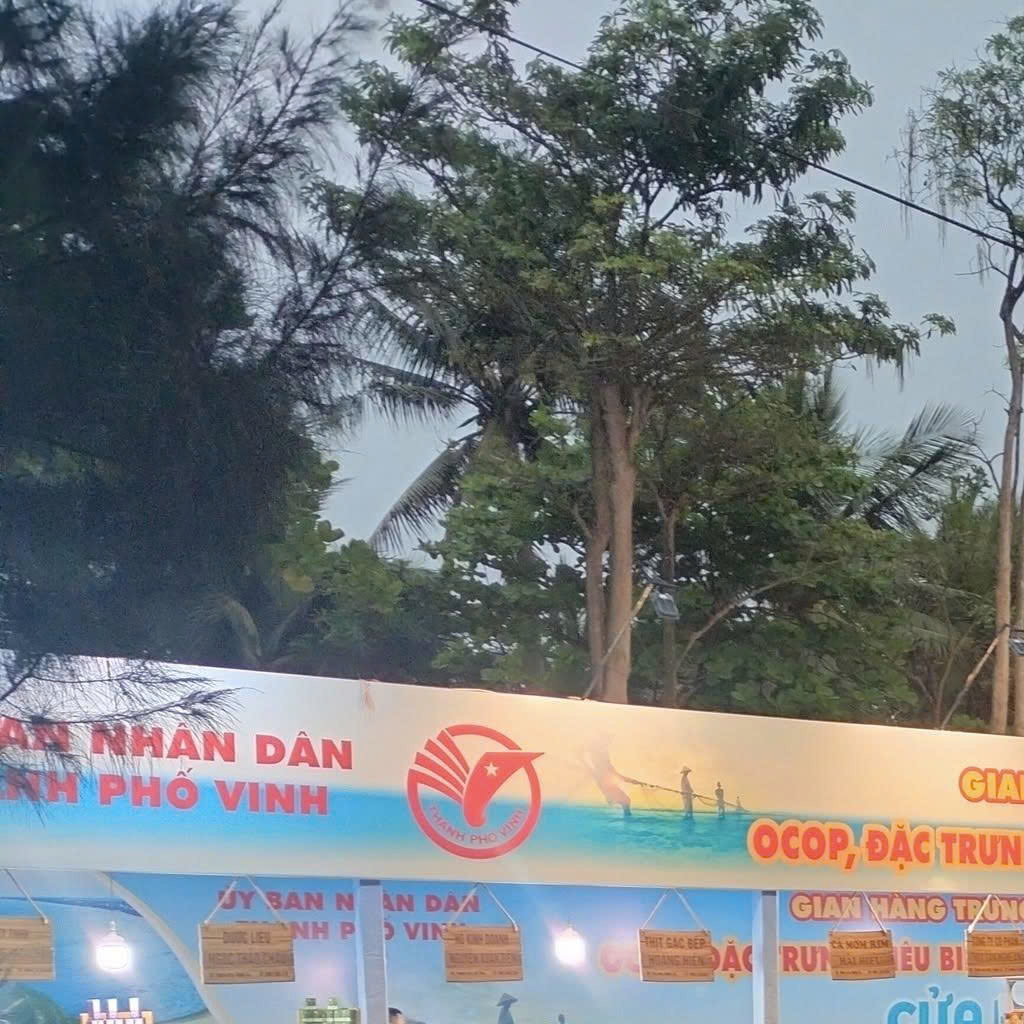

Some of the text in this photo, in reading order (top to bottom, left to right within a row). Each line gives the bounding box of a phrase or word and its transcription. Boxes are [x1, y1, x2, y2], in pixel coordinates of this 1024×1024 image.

[91, 722, 236, 762] NHÂN
[256, 731, 353, 769] DÂN
[100, 768, 198, 809] PHỐ
[214, 780, 328, 815] VINH
[753, 823, 856, 870] OCOP,
[865, 824, 930, 870] ĐẶC
[265, 891, 323, 910] BAN
[426, 889, 480, 912] DÂN
[789, 892, 862, 921] GIAN
[869, 892, 948, 923] HÀNG
